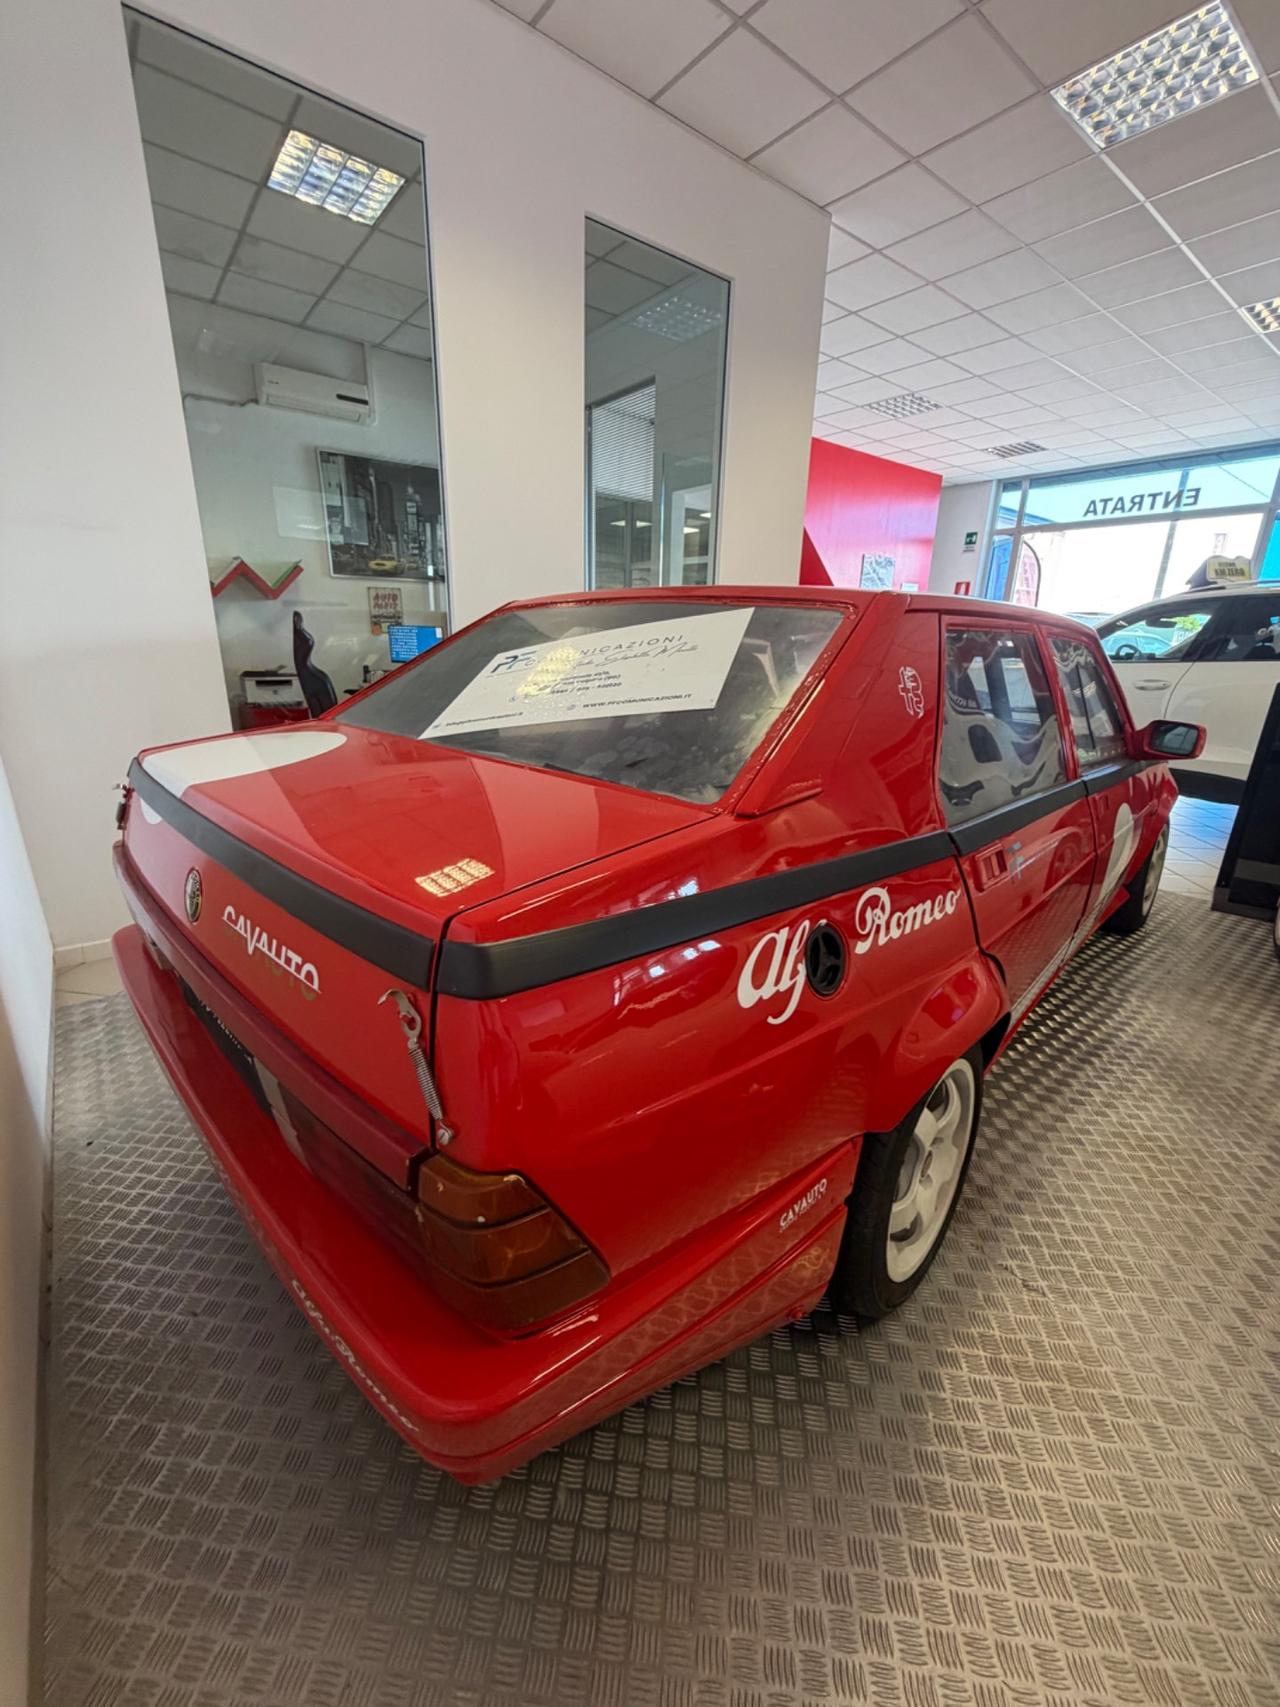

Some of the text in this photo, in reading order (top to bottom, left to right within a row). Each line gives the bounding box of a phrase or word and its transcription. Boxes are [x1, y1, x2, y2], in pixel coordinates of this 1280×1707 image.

[373, 592, 398, 602] AUTO
[222, 905, 321, 994] CAVAUTO
[737, 886, 961, 1025] Alf Romeo
[780, 1178, 827, 1228] CAVAUTO
